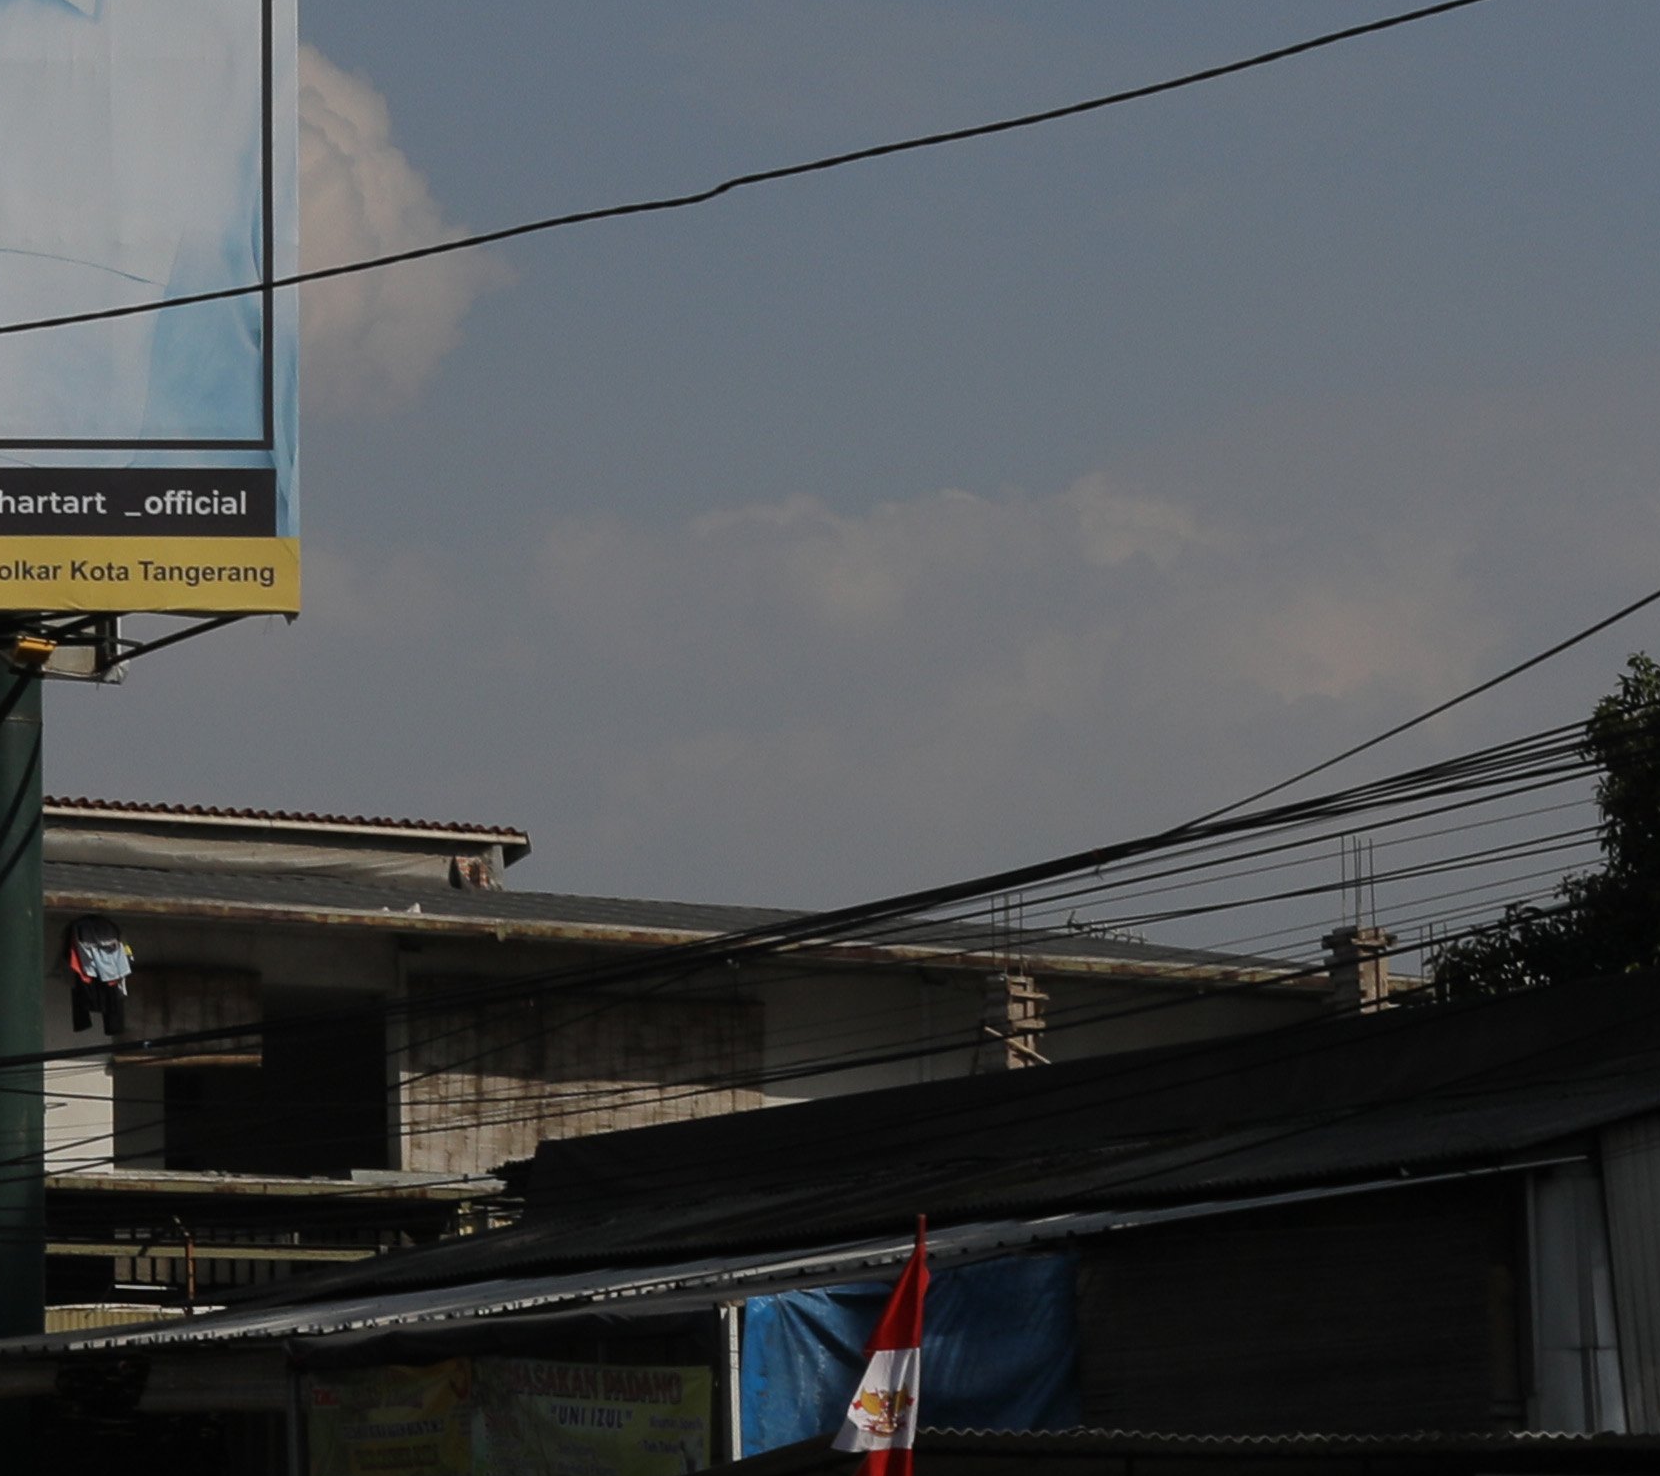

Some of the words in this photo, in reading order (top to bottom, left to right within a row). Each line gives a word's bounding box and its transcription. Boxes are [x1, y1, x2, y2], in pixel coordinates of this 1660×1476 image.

[124, 489, 247, 518] _official
[71, 561, 130, 581] Kota
[138, 561, 275, 587] Tangerang
